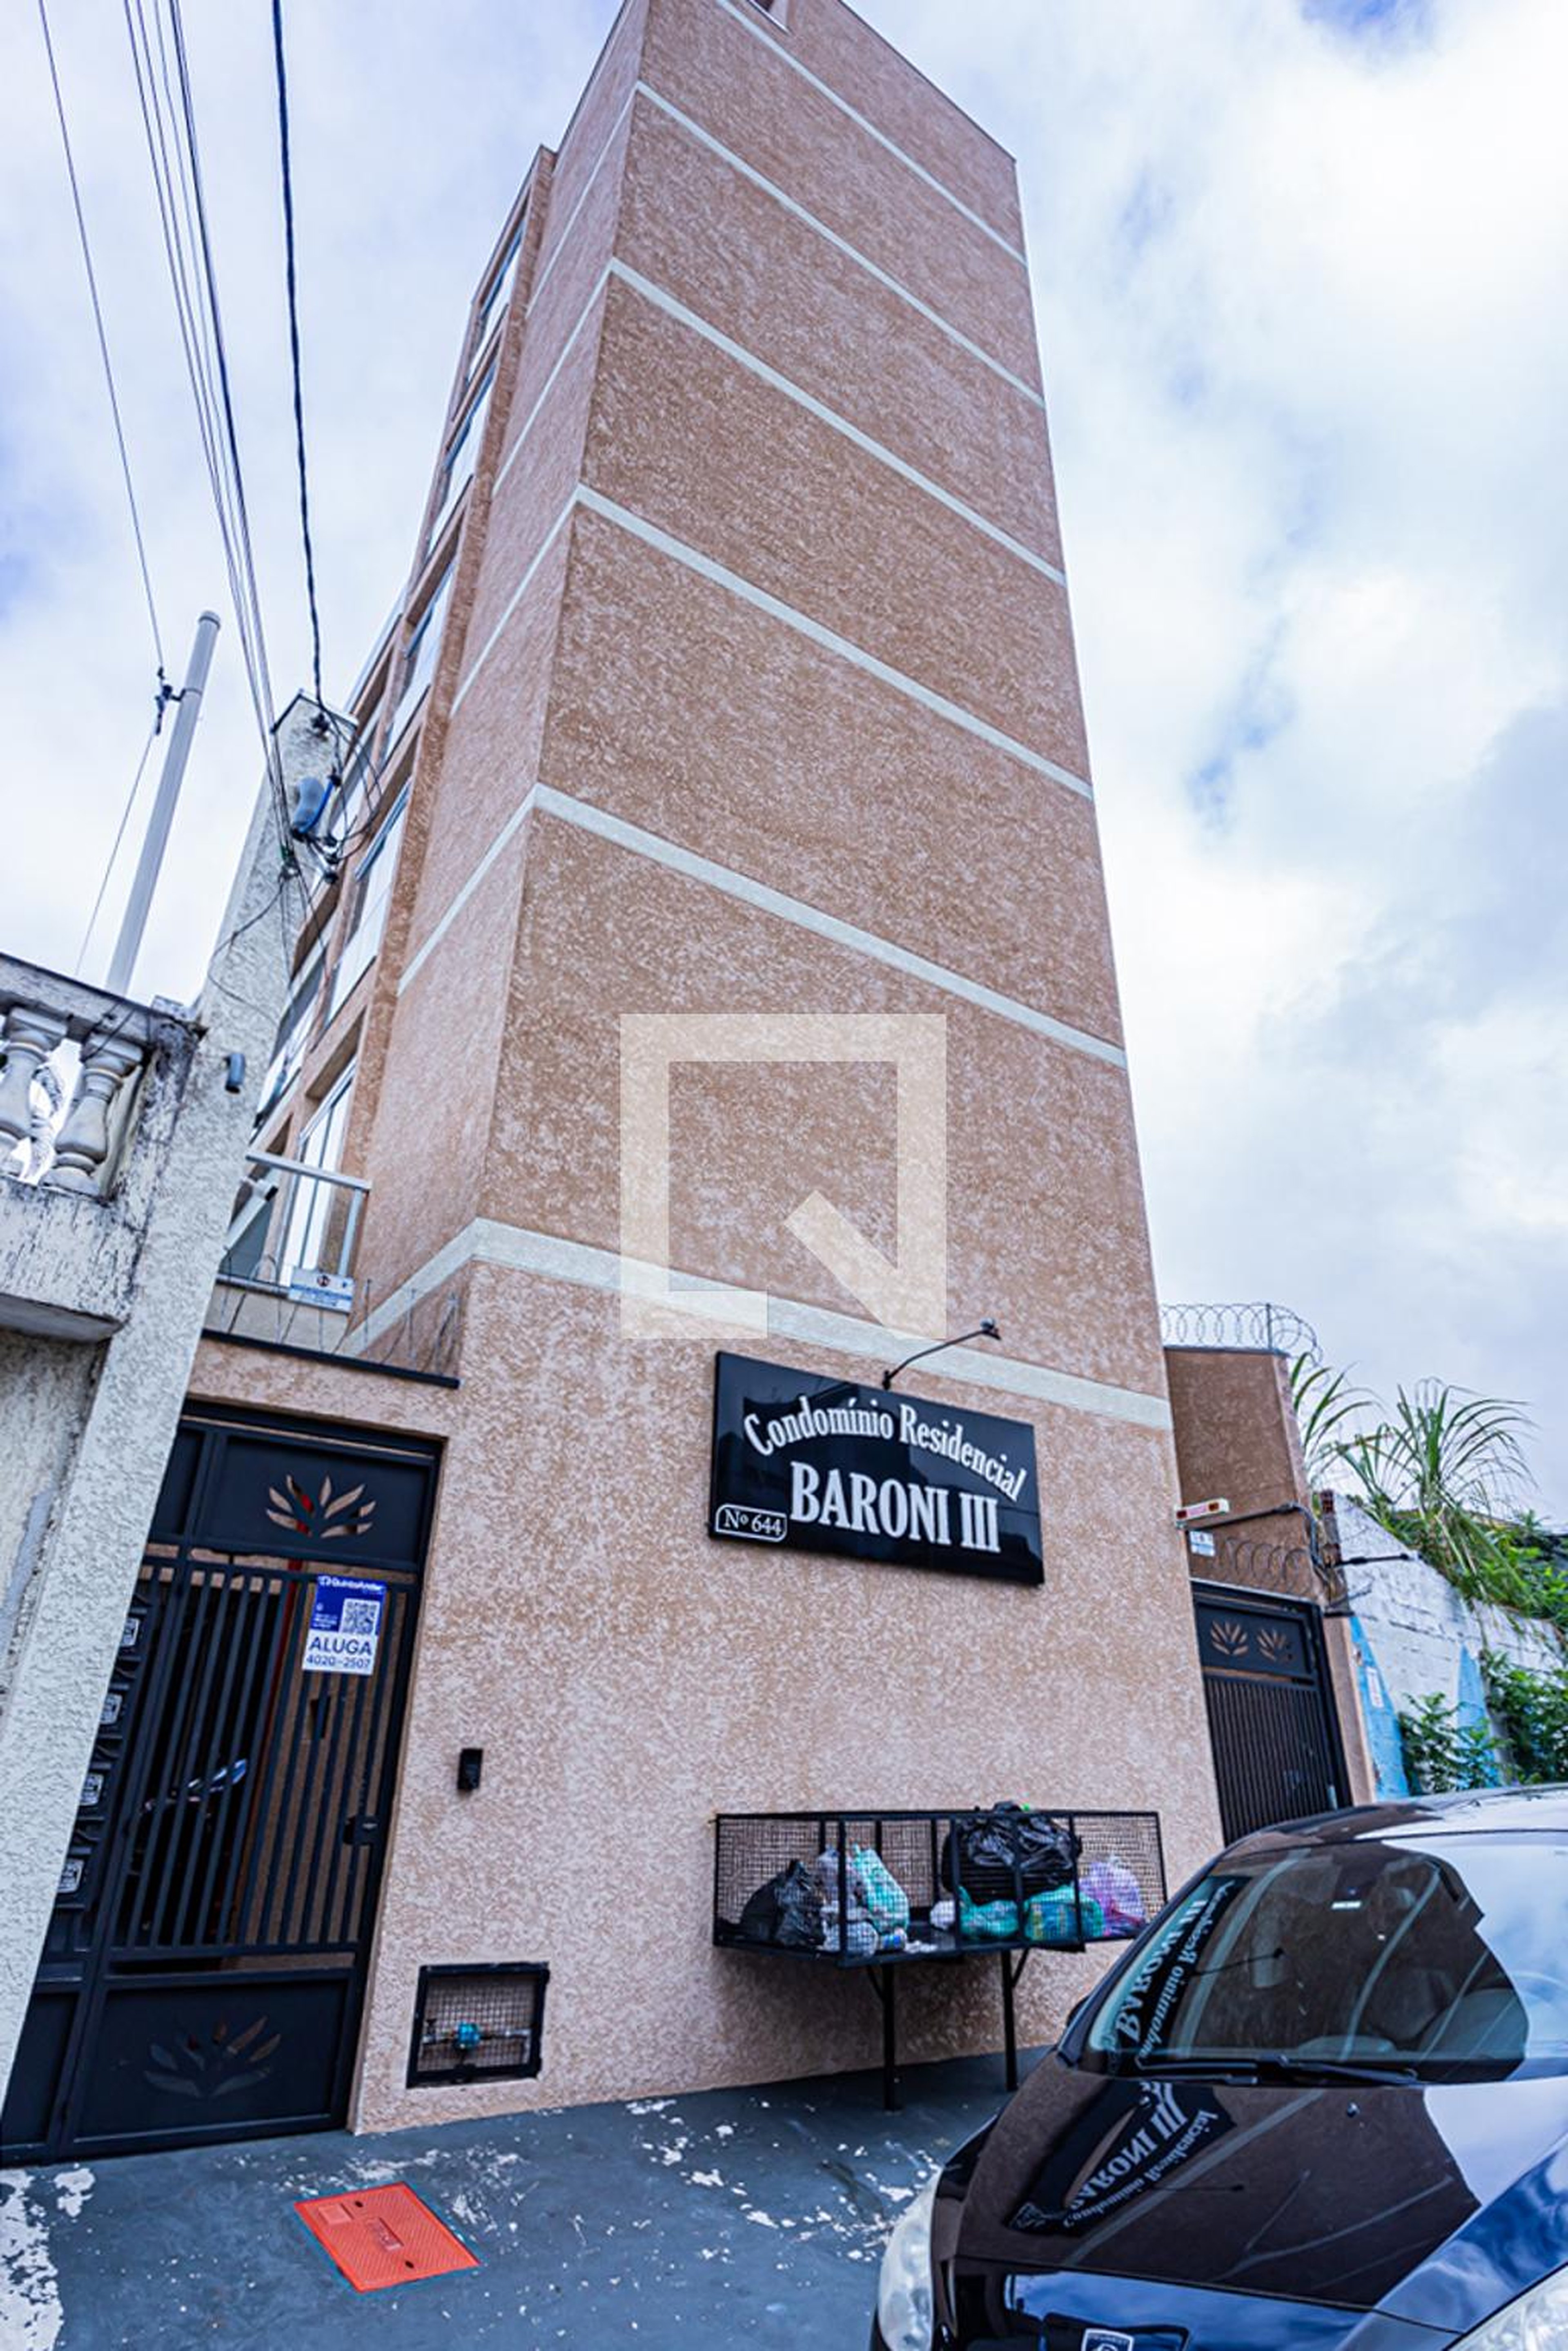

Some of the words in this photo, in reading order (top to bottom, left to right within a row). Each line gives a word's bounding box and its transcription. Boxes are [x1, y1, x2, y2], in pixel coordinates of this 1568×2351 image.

[743, 1395, 894, 1456] Condomínio
[900, 1403, 1027, 1502] Residencial
[751, 1514, 782, 1536] 644
[790, 1461, 952, 1546] BARONI
[960, 1492, 1000, 1552] III
[308, 1636, 372, 1655] ALUGA
